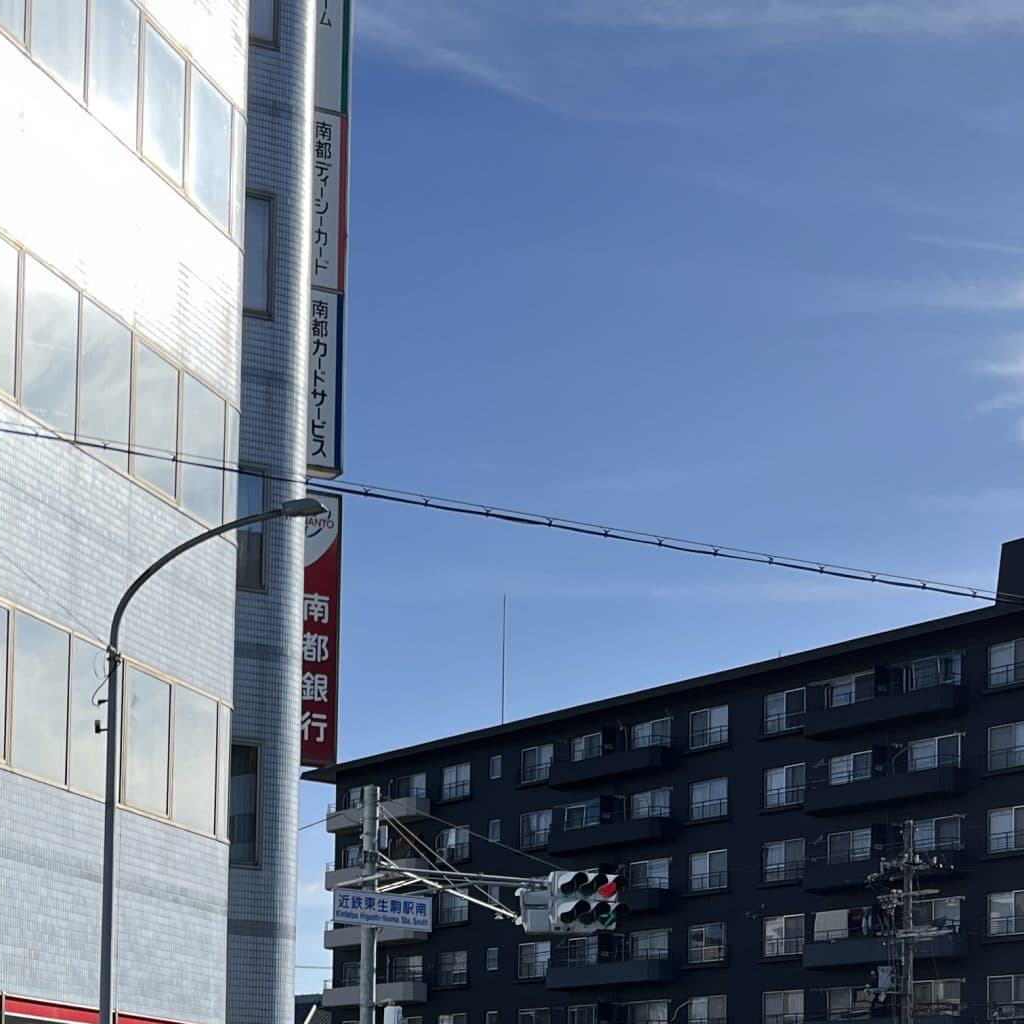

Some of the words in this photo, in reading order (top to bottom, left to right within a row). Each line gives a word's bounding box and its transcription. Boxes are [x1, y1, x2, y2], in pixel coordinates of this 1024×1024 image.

[314, 121, 332, 275] 南都ディーシーカード
[311, 299, 329, 458] 南都カードサービス
[301, 592, 330, 742] 南都銀行
[337, 894, 427, 917] 近鉄東生駒駅南
